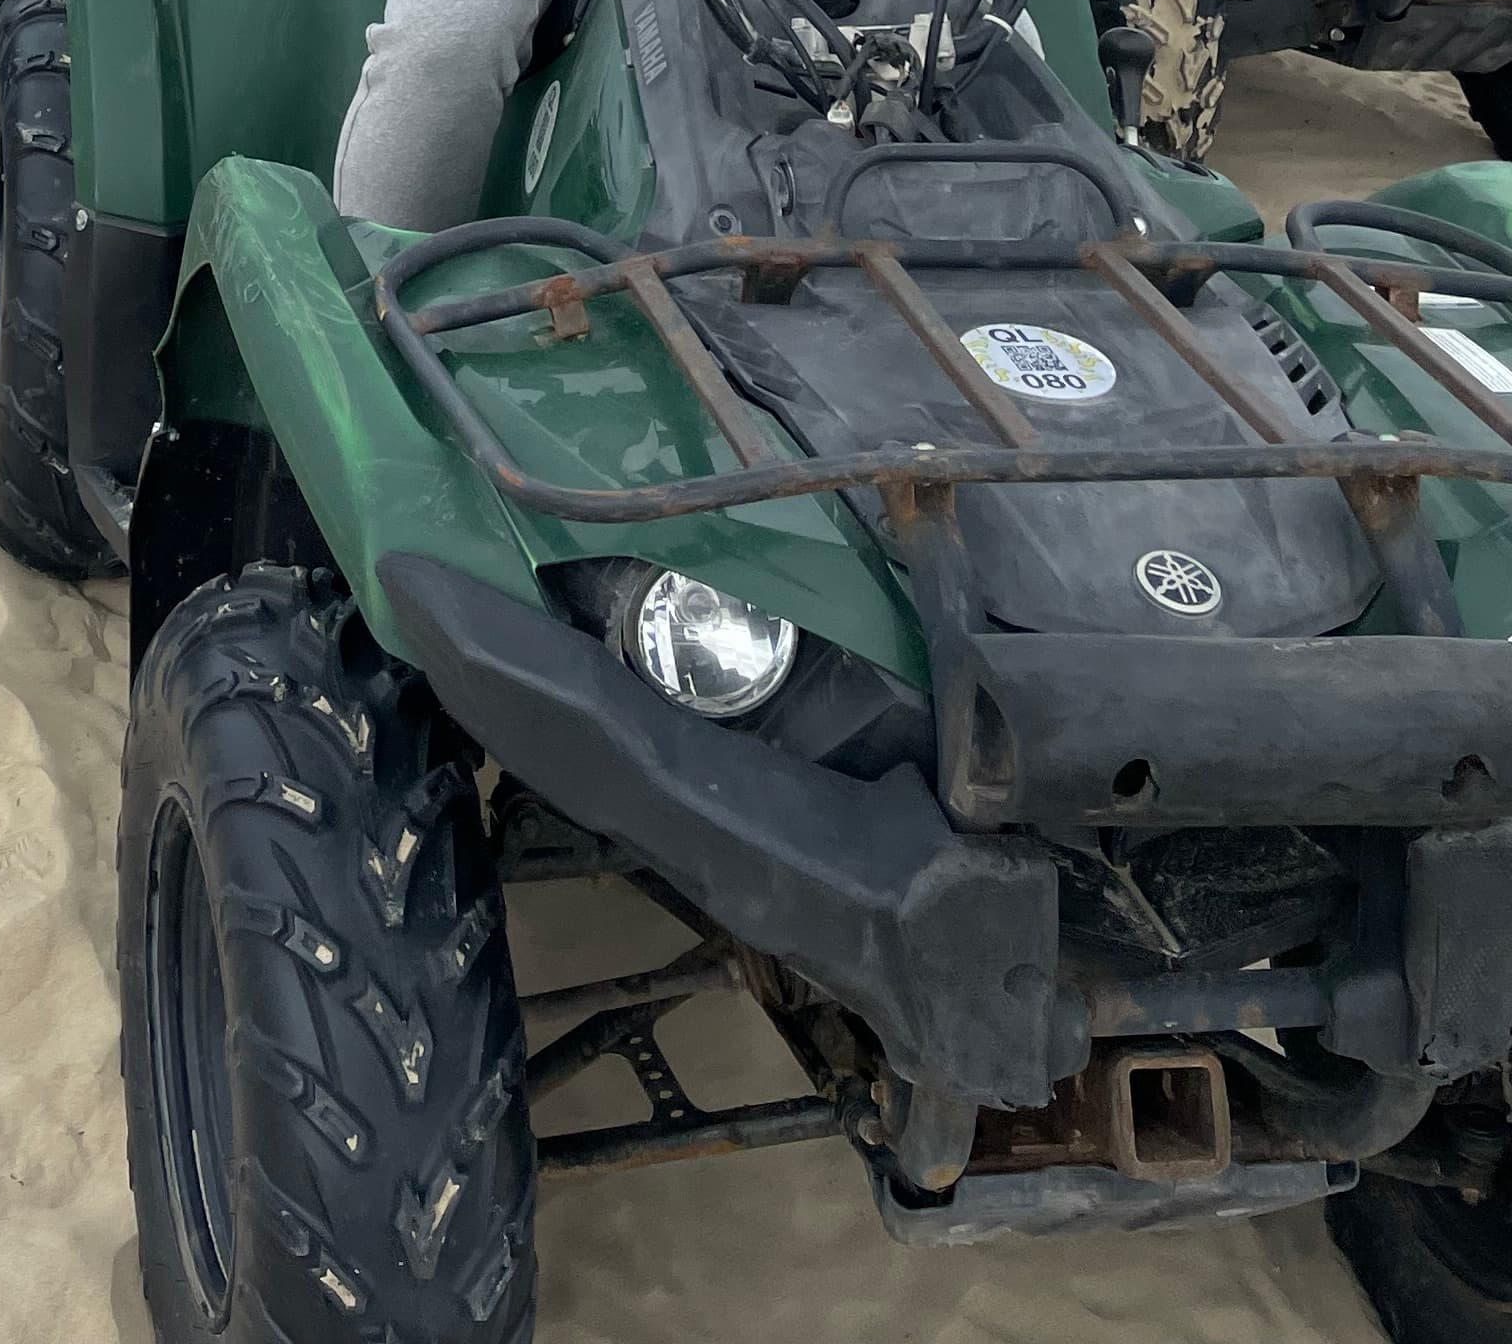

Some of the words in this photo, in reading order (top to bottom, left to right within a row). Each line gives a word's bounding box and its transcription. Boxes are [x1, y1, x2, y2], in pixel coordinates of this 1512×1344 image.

[633, 0, 668, 86] YAMAHA
[988, 328, 1044, 344] QL
[1021, 372, 1088, 391] 080
